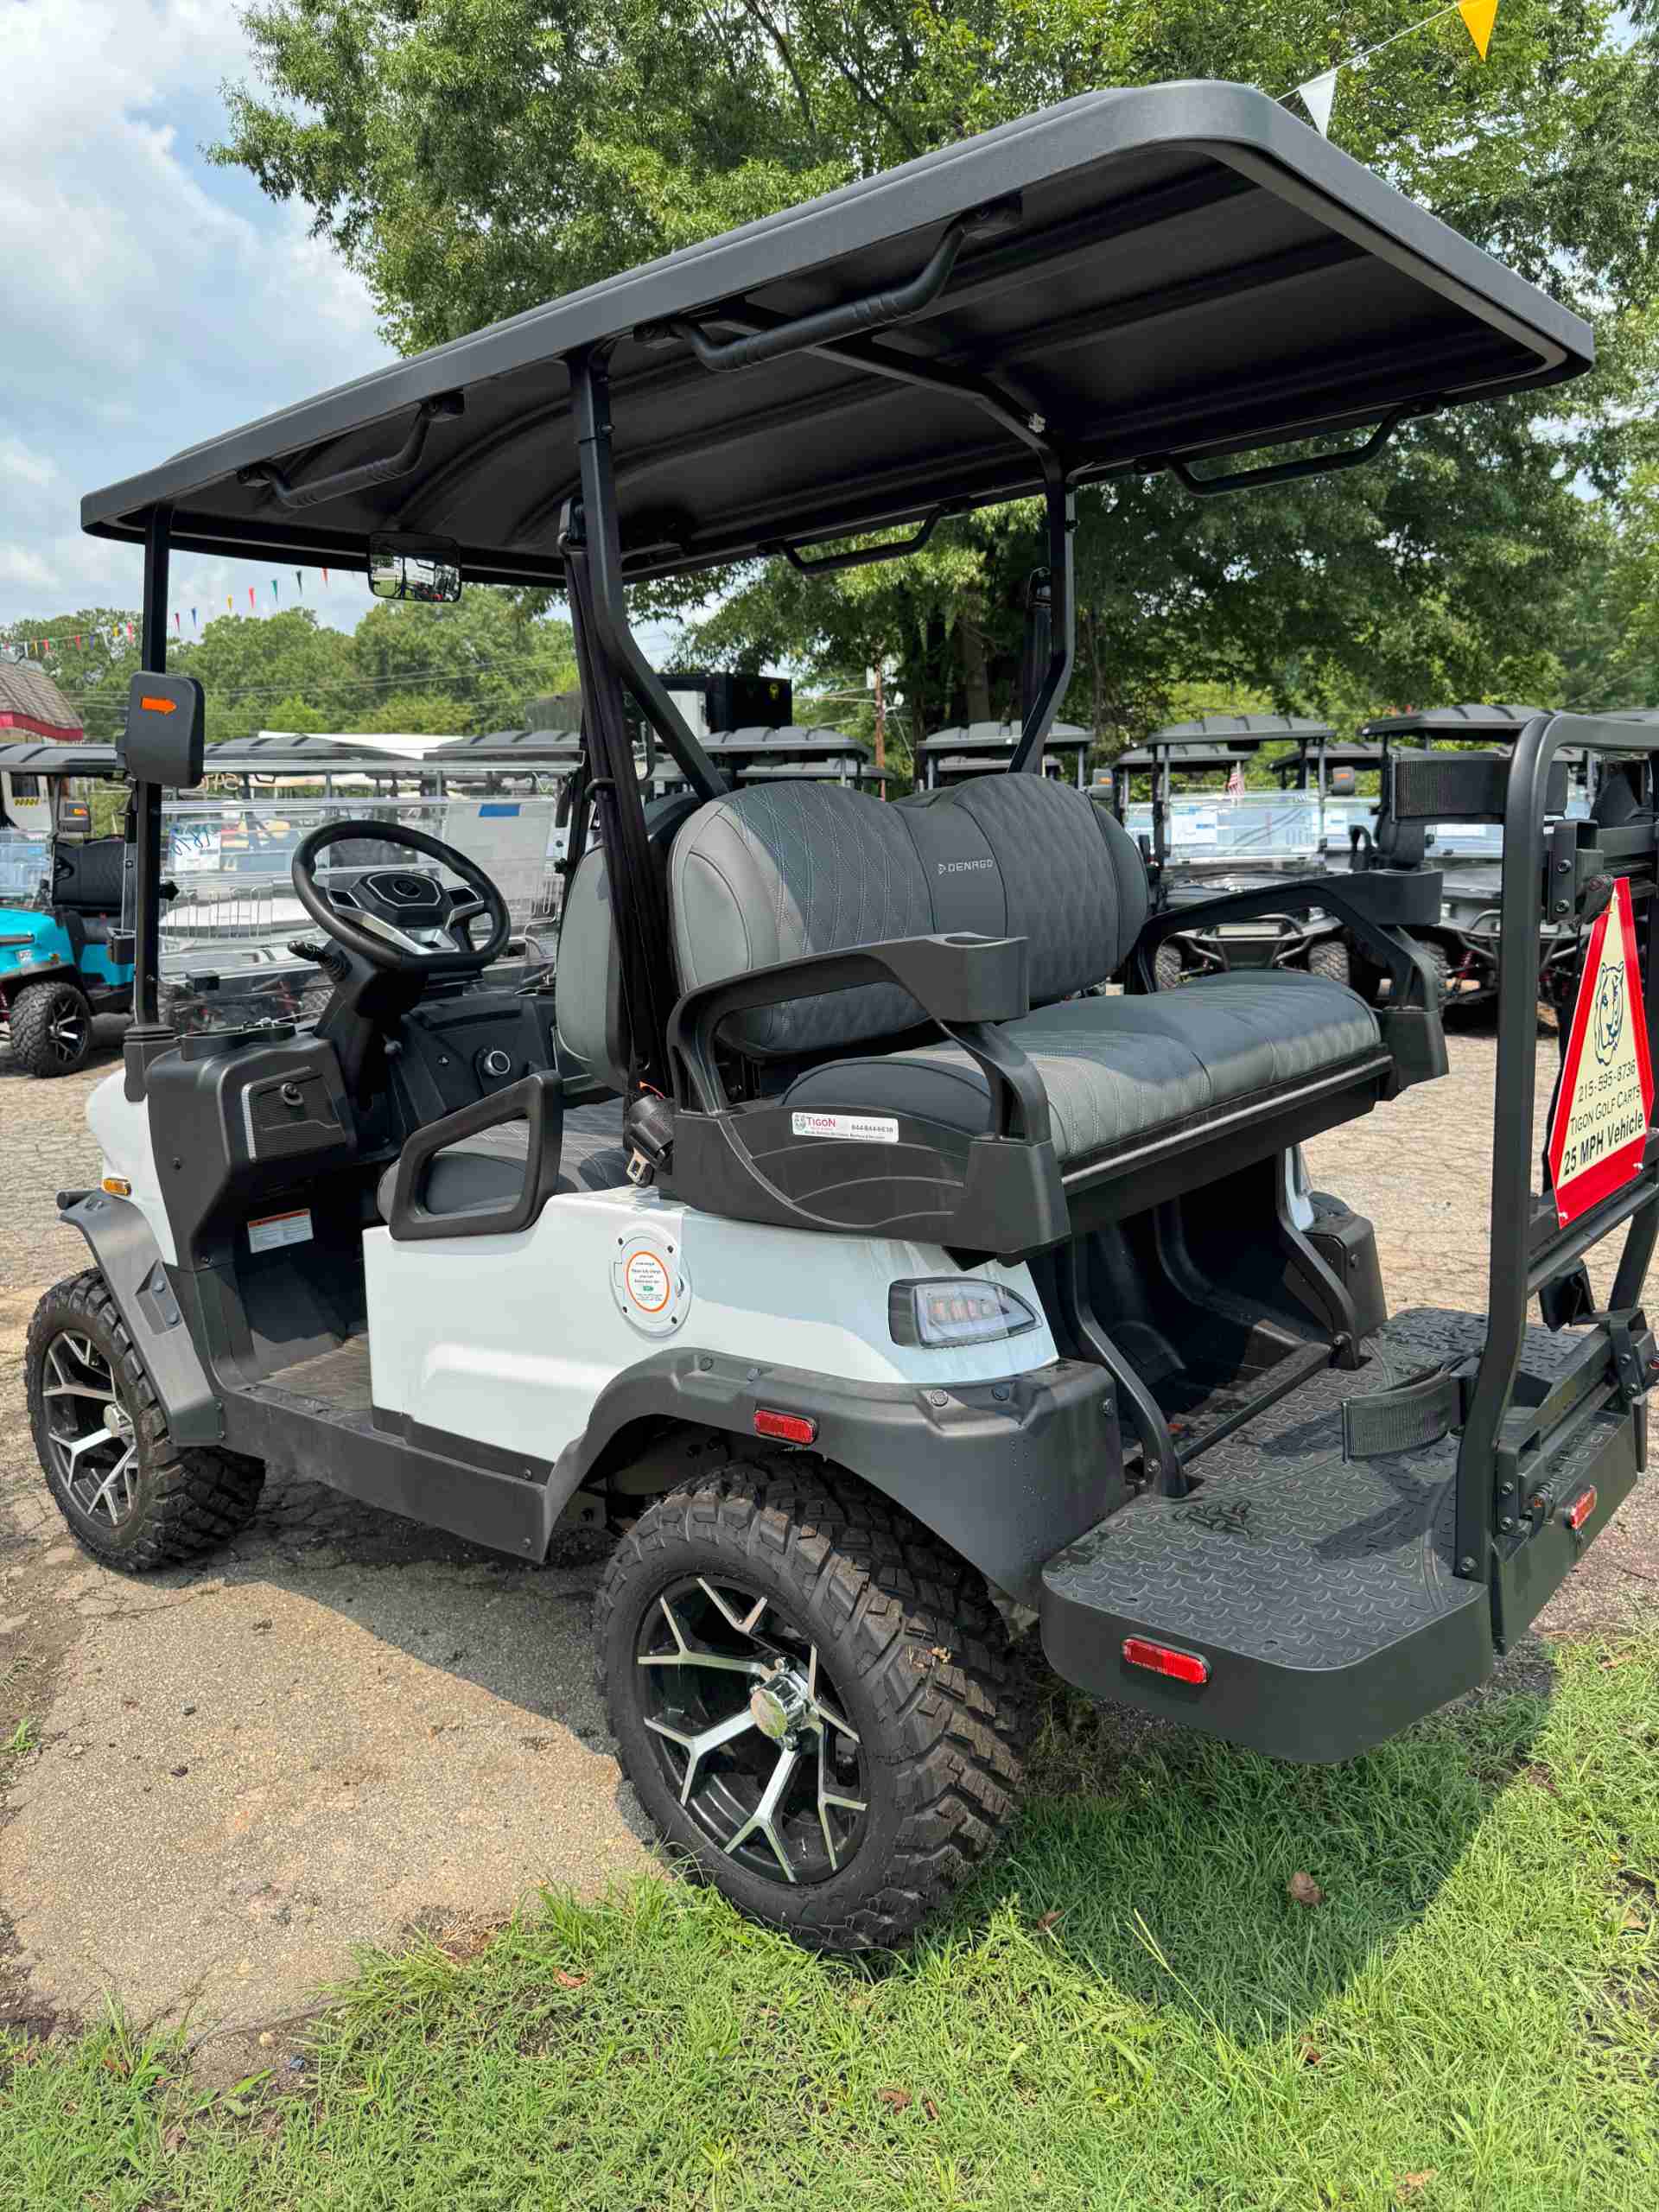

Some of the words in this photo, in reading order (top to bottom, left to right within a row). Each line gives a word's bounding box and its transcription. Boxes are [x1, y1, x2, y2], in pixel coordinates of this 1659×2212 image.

[948, 859, 993, 872] DENAGO
[1578, 1058, 1636, 1103] 215-595-8736
[806, 1116, 836, 1128] TIGON
[1570, 1107, 1593, 1135] TIGON
[1595, 1097, 1616, 1121] GOLF
[1617, 1084, 1641, 1108] CARTS
[1562, 1147, 1577, 1177] 25
[1580, 1129, 1604, 1166] MPH
[1607, 1109, 1643, 1147] Vehicle
